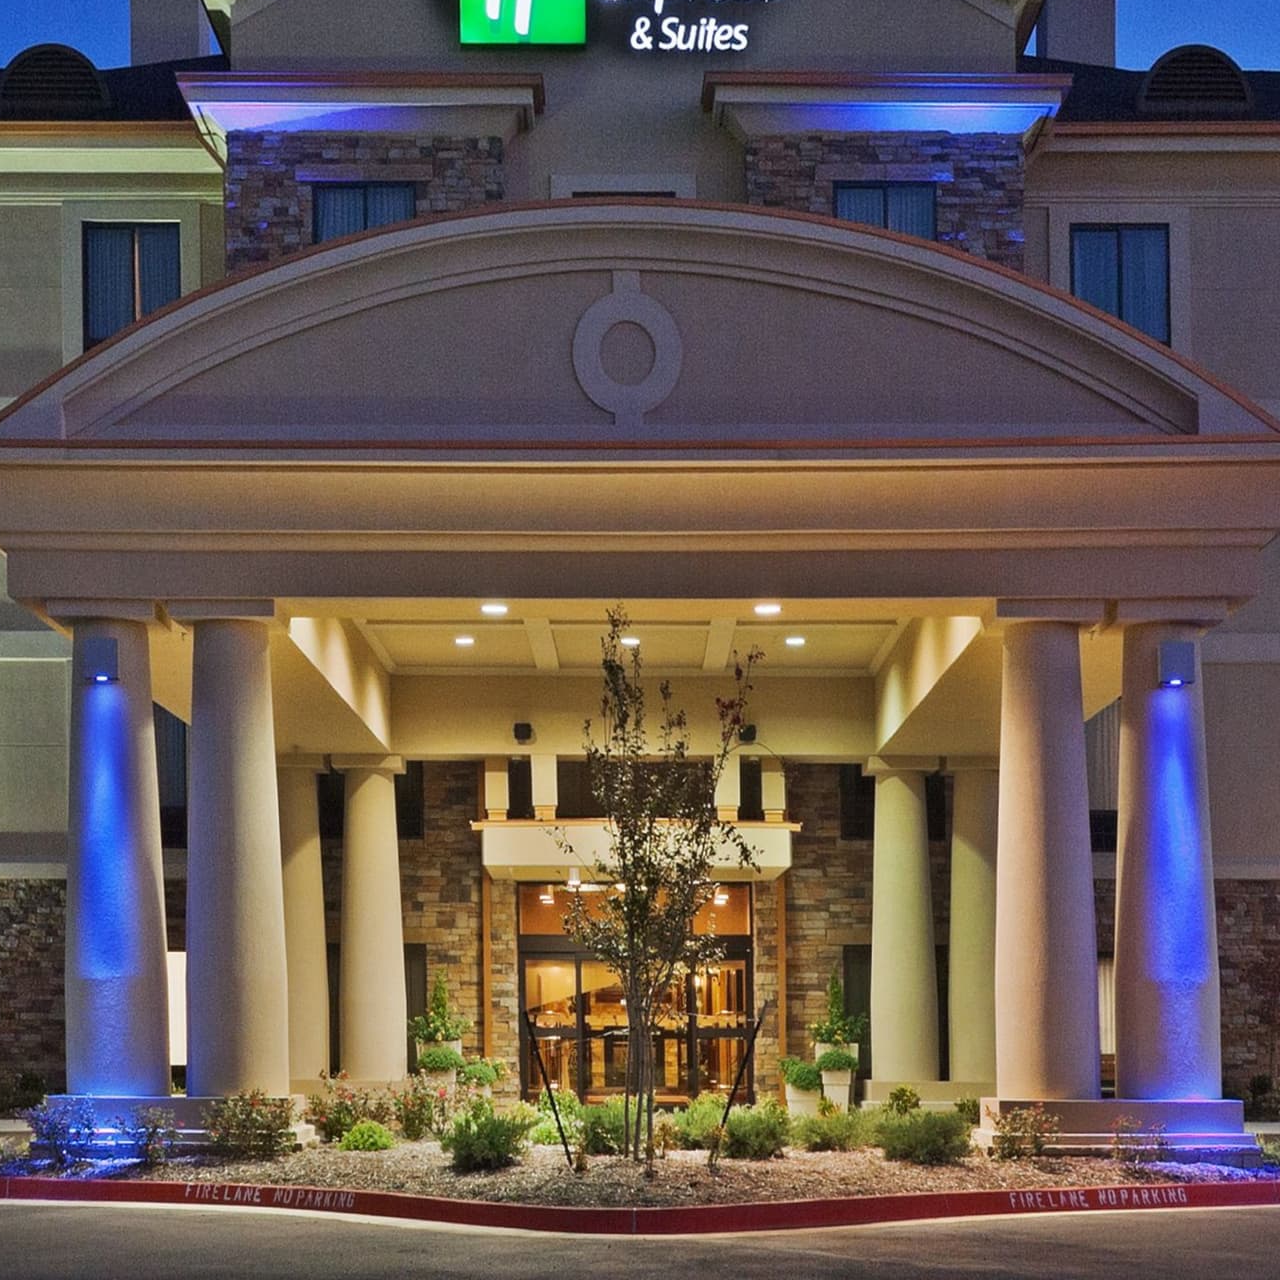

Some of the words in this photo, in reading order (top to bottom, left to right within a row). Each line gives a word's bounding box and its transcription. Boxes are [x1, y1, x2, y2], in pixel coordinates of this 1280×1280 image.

[630, 17, 653, 50] &
[658, 17, 749, 52] Suites
[185, 1183, 219, 1201] FIRE
[223, 1185, 262, 1203] LANE
[273, 1187, 294, 1205] NO
[295, 1189, 356, 1209] PARKING
[1009, 1191, 1046, 1209] FIRE
[1047, 1190, 1089, 1209] LANE
[1098, 1188, 1118, 1206] NO
[1119, 1186, 1188, 1207] PARKING
